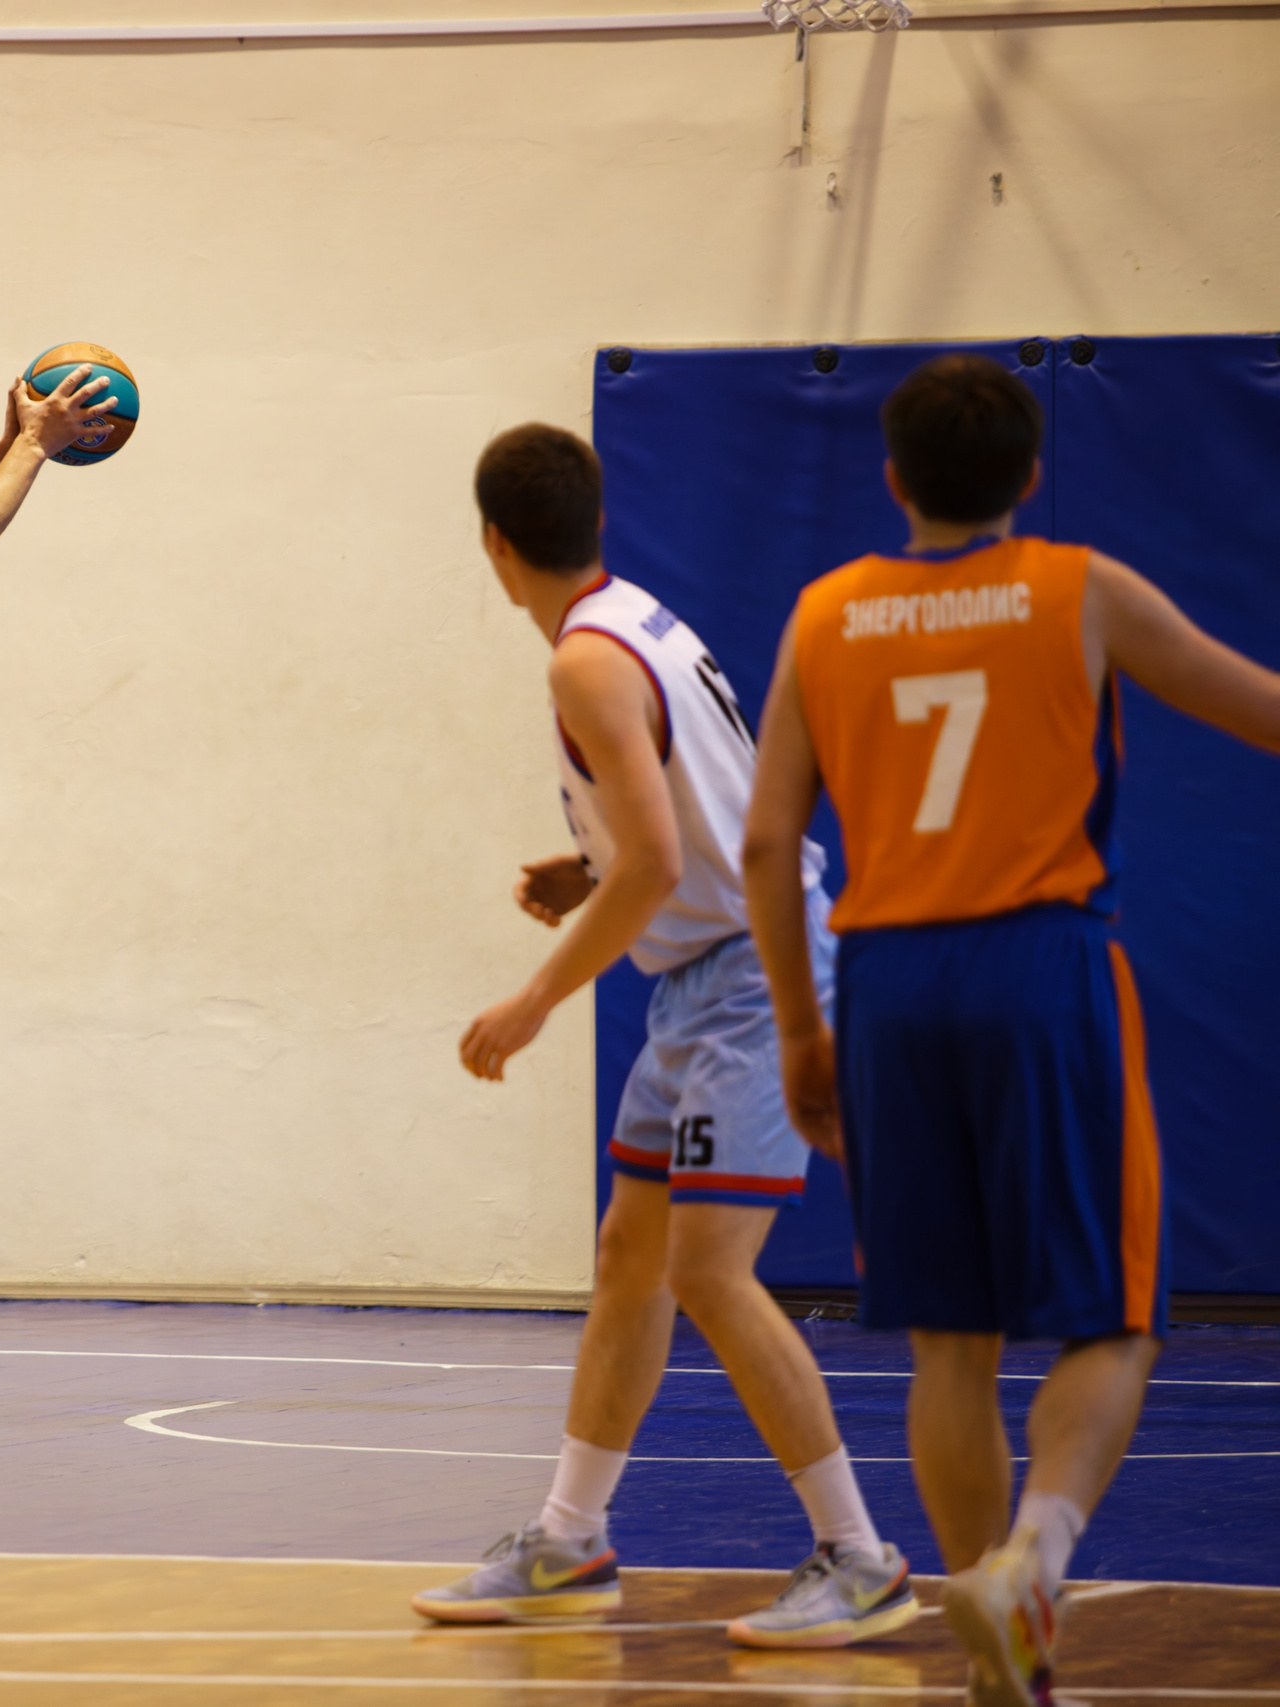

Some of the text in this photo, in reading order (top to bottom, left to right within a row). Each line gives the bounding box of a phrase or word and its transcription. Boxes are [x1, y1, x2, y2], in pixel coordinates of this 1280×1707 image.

[841, 581, 1032, 642] ЭНЕРГОПОЛИС
[891, 668, 988, 833] 7
[675, 1115, 714, 1168] 15
